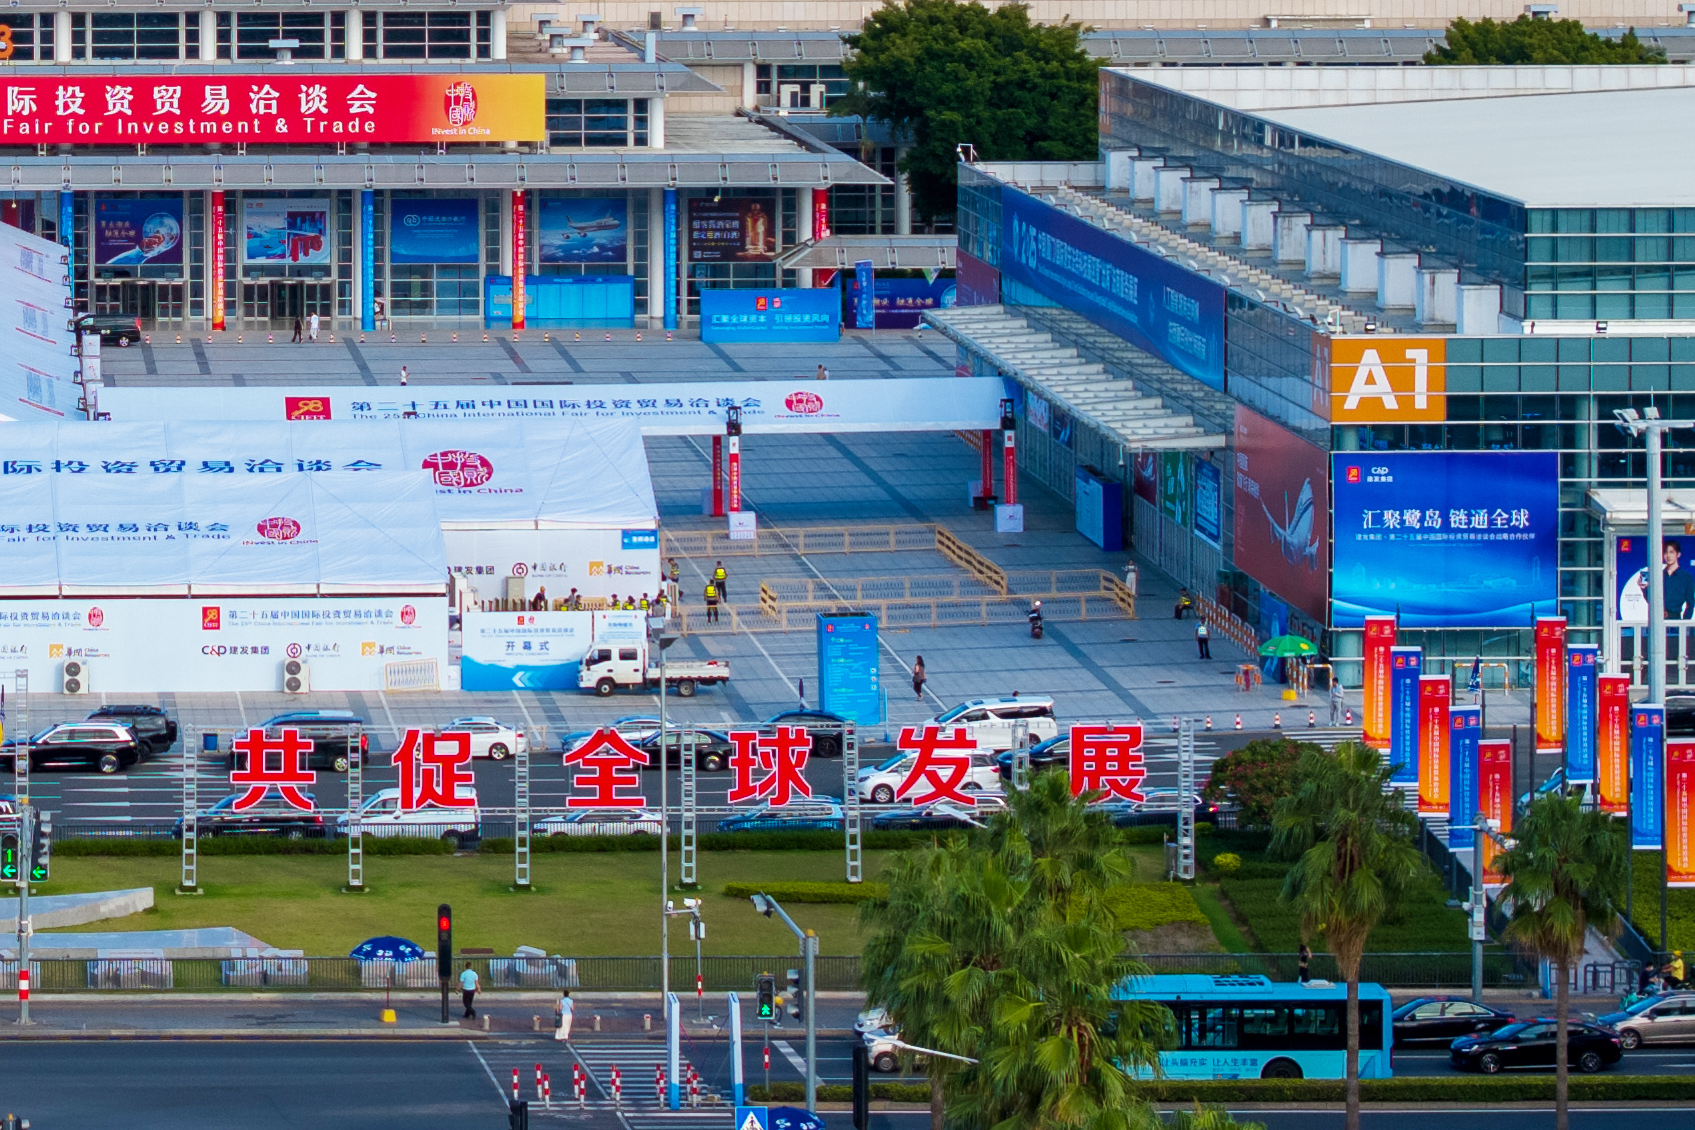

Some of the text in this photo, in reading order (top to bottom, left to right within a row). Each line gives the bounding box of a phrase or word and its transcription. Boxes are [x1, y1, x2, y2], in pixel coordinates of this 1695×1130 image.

[3, 119, 53, 136] Fair
[67, 119, 103, 136] for
[117, 117, 261, 135] Investment
[275, 117, 289, 135] &
[304, 117, 376, 135] Trade
[1343, 348, 1428, 410] A1
[350, 397, 762, 412] 第二十五届中国国际投资贸易洽谈会
[477, 487, 524, 495] China
[1362, 508, 1530, 530] 汇聚鹭岛 链通全球
[228, 609, 394, 620] 第二十五届中国国际投资贸易洽谈会
[202, 644, 227, 656] C&D
[229, 645, 270, 655] 建发集团
[505, 640, 550, 651] 开幕式
[230, 724, 1147, 813] 共促全球发展
[1161, 1057, 1259, 1067] 让头脑充实 让人生丰富
